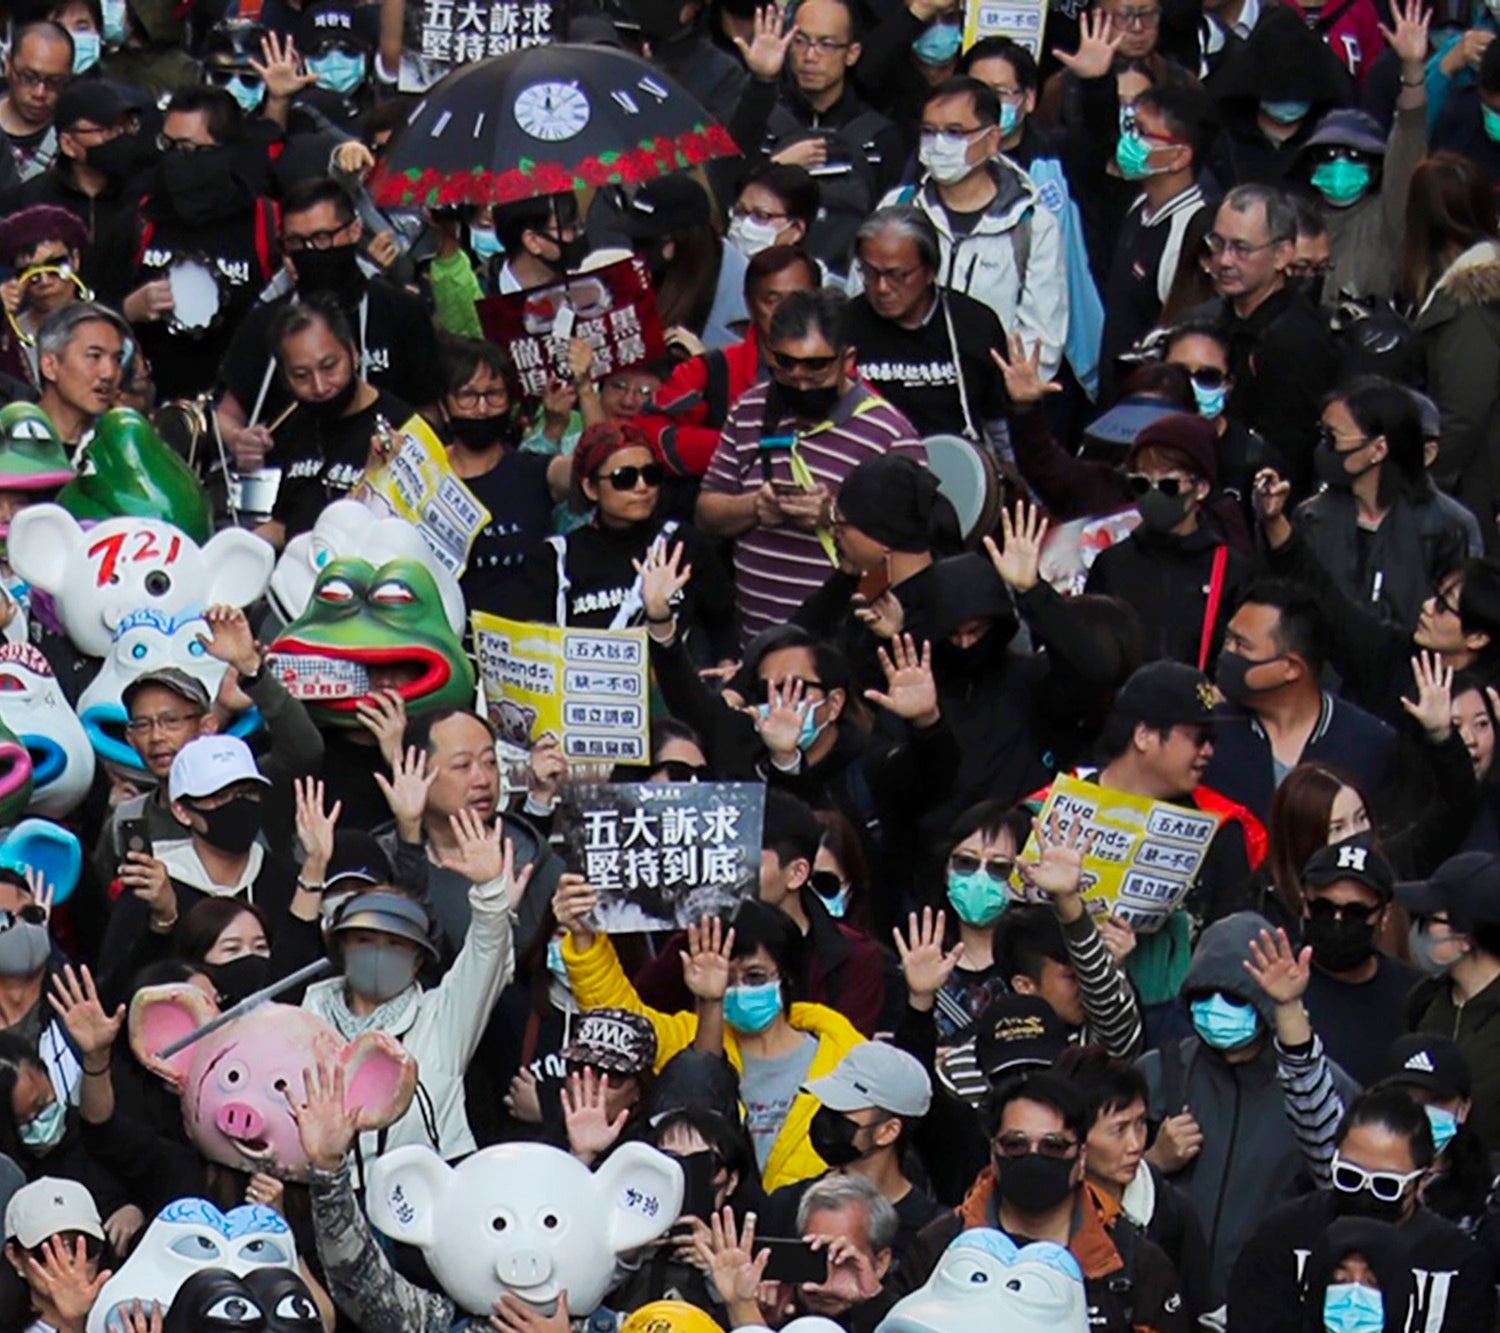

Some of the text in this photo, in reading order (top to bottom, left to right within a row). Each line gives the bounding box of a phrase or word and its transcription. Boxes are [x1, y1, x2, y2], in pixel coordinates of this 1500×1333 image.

[423, 1, 553, 36] 五大訴求
[422, 34, 553, 62] 堅持到
[583, 805, 741, 848] 五大訴求
[585, 844, 739, 890] 堅持到底
